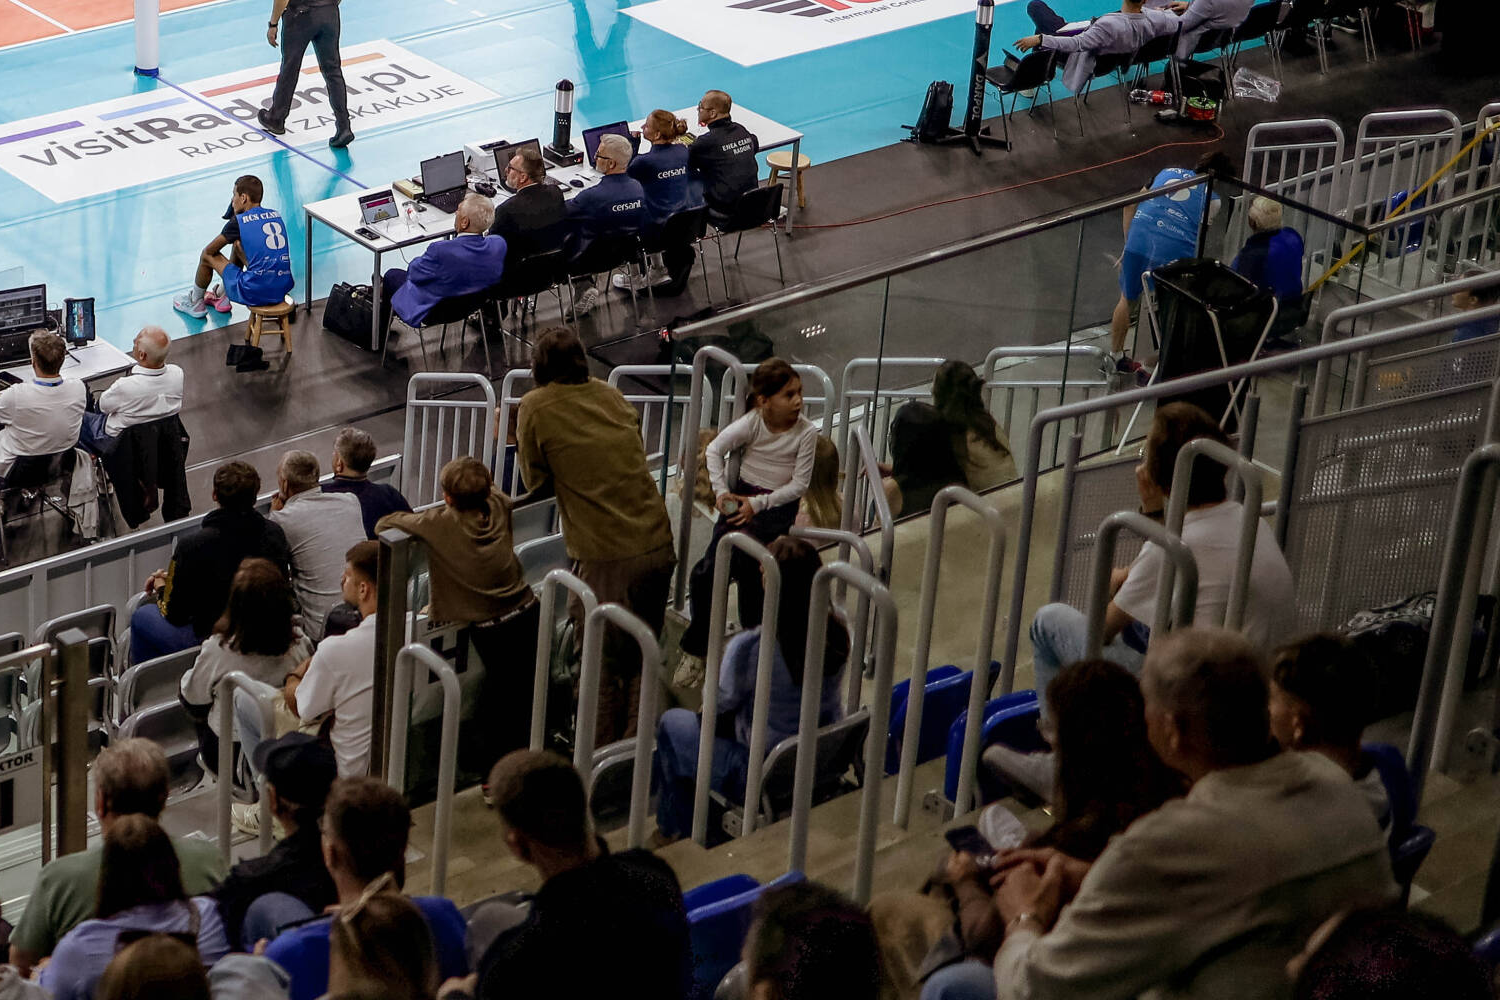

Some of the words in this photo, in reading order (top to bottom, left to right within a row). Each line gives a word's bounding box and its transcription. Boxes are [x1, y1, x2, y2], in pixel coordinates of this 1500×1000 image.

[972, 73, 985, 121] DARPOL
[178, 118, 296, 160] RADO
[262, 222, 286, 250] 8
